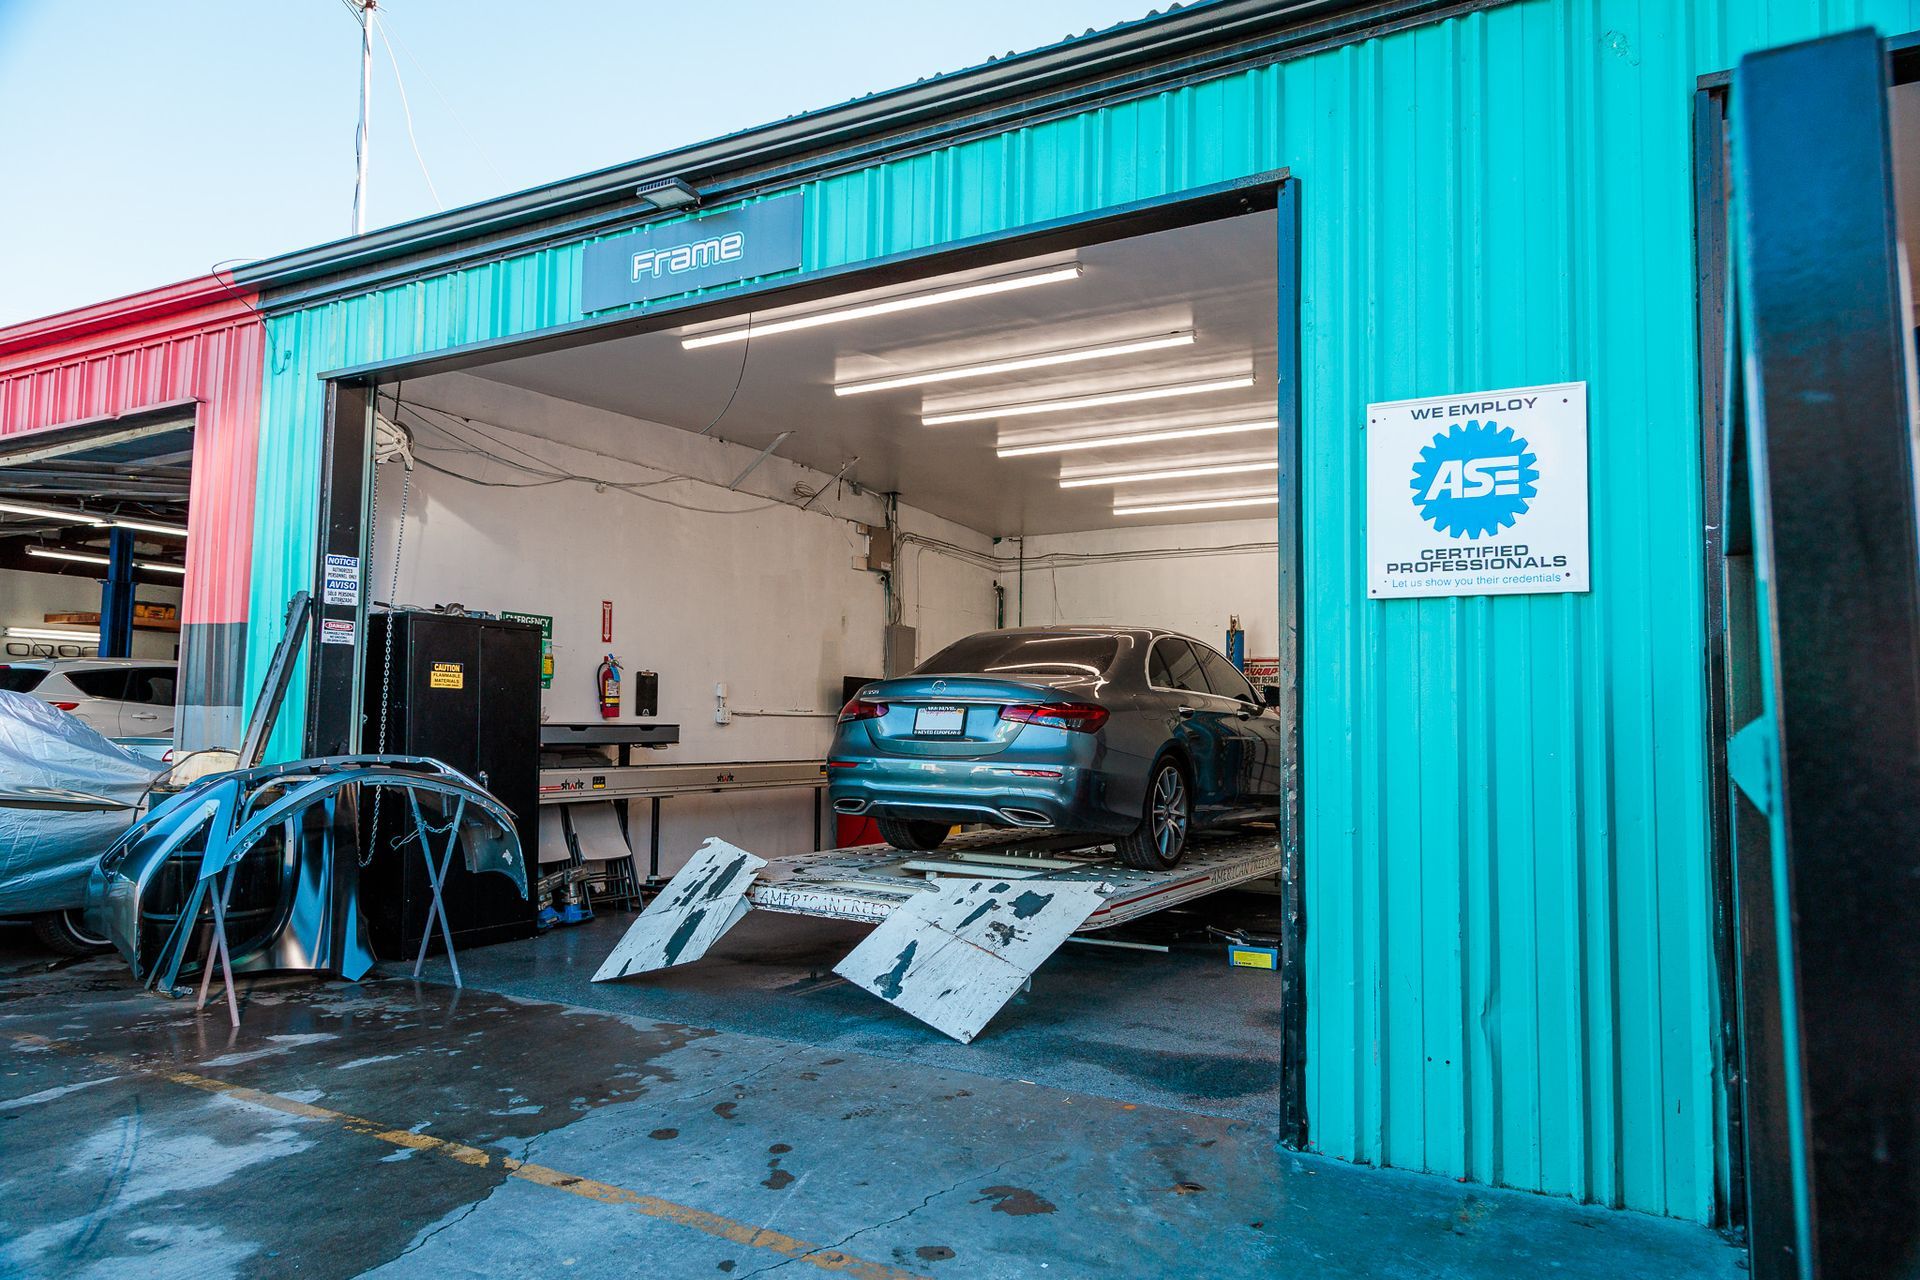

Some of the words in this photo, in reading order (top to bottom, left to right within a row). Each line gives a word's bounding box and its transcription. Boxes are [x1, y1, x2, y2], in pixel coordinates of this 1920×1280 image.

[632, 233, 743, 281] Frame
[1411, 407, 1444, 420] WE
[1448, 397, 1538, 416] EMPLOY
[1424, 455, 1520, 501] ASE
[328, 556, 357, 566] NOTICE
[1420, 545, 1529, 561] CERTIFIED
[1387, 555, 1568, 574] PROFESSIONALS
[328, 580, 356, 590] AVISO
[1392, 579, 1409, 588] Let
[1425, 578, 1452, 587] show
[1455, 578, 1473, 589] you
[1476, 575, 1498, 585] their
[1502, 573, 1561, 584] credentials
[434, 663, 460, 672] CAUTION
[1211, 861, 1249, 884] AMERICAN
